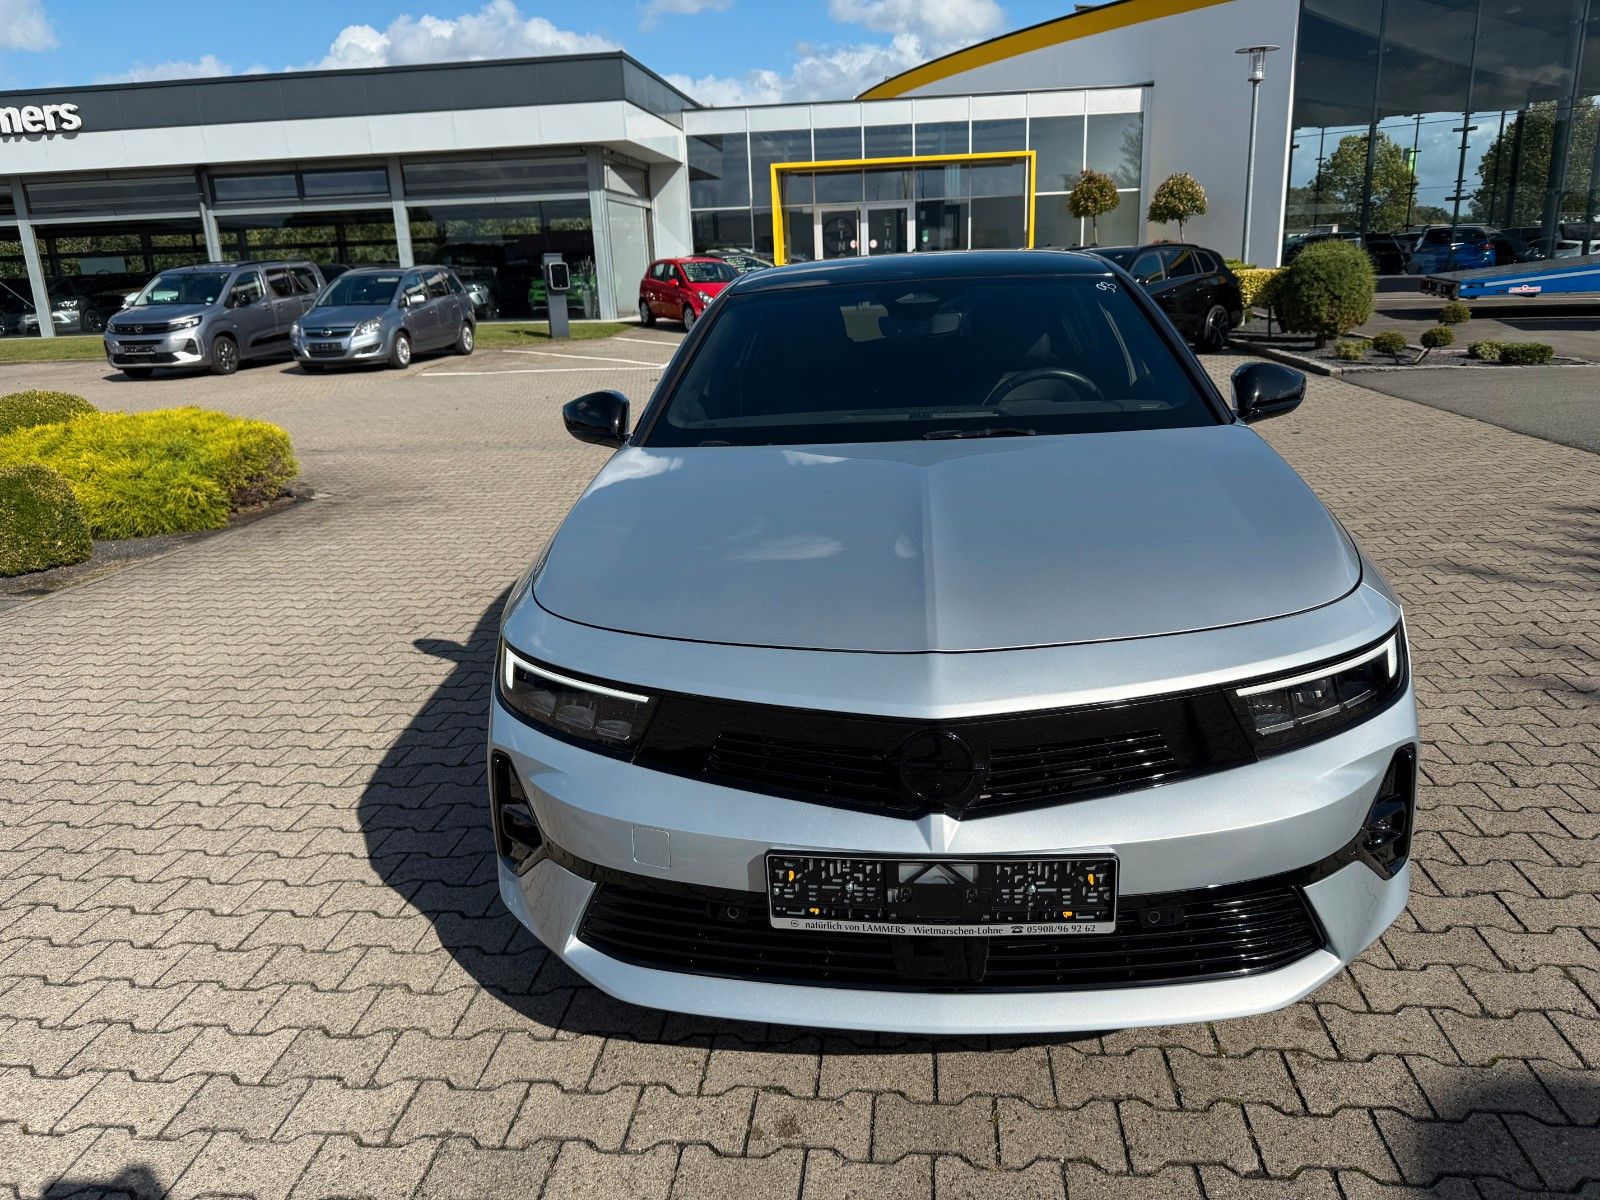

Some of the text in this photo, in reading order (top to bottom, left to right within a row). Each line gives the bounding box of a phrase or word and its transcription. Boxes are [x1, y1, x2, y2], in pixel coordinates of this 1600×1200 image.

[805, 921, 842, 931] natürlich
[862, 924, 906, 934] LAMMERS
[913, 926, 1003, 935] Wietmarschen-Lohne
[1026, 925, 1069, 934] 05908/96
